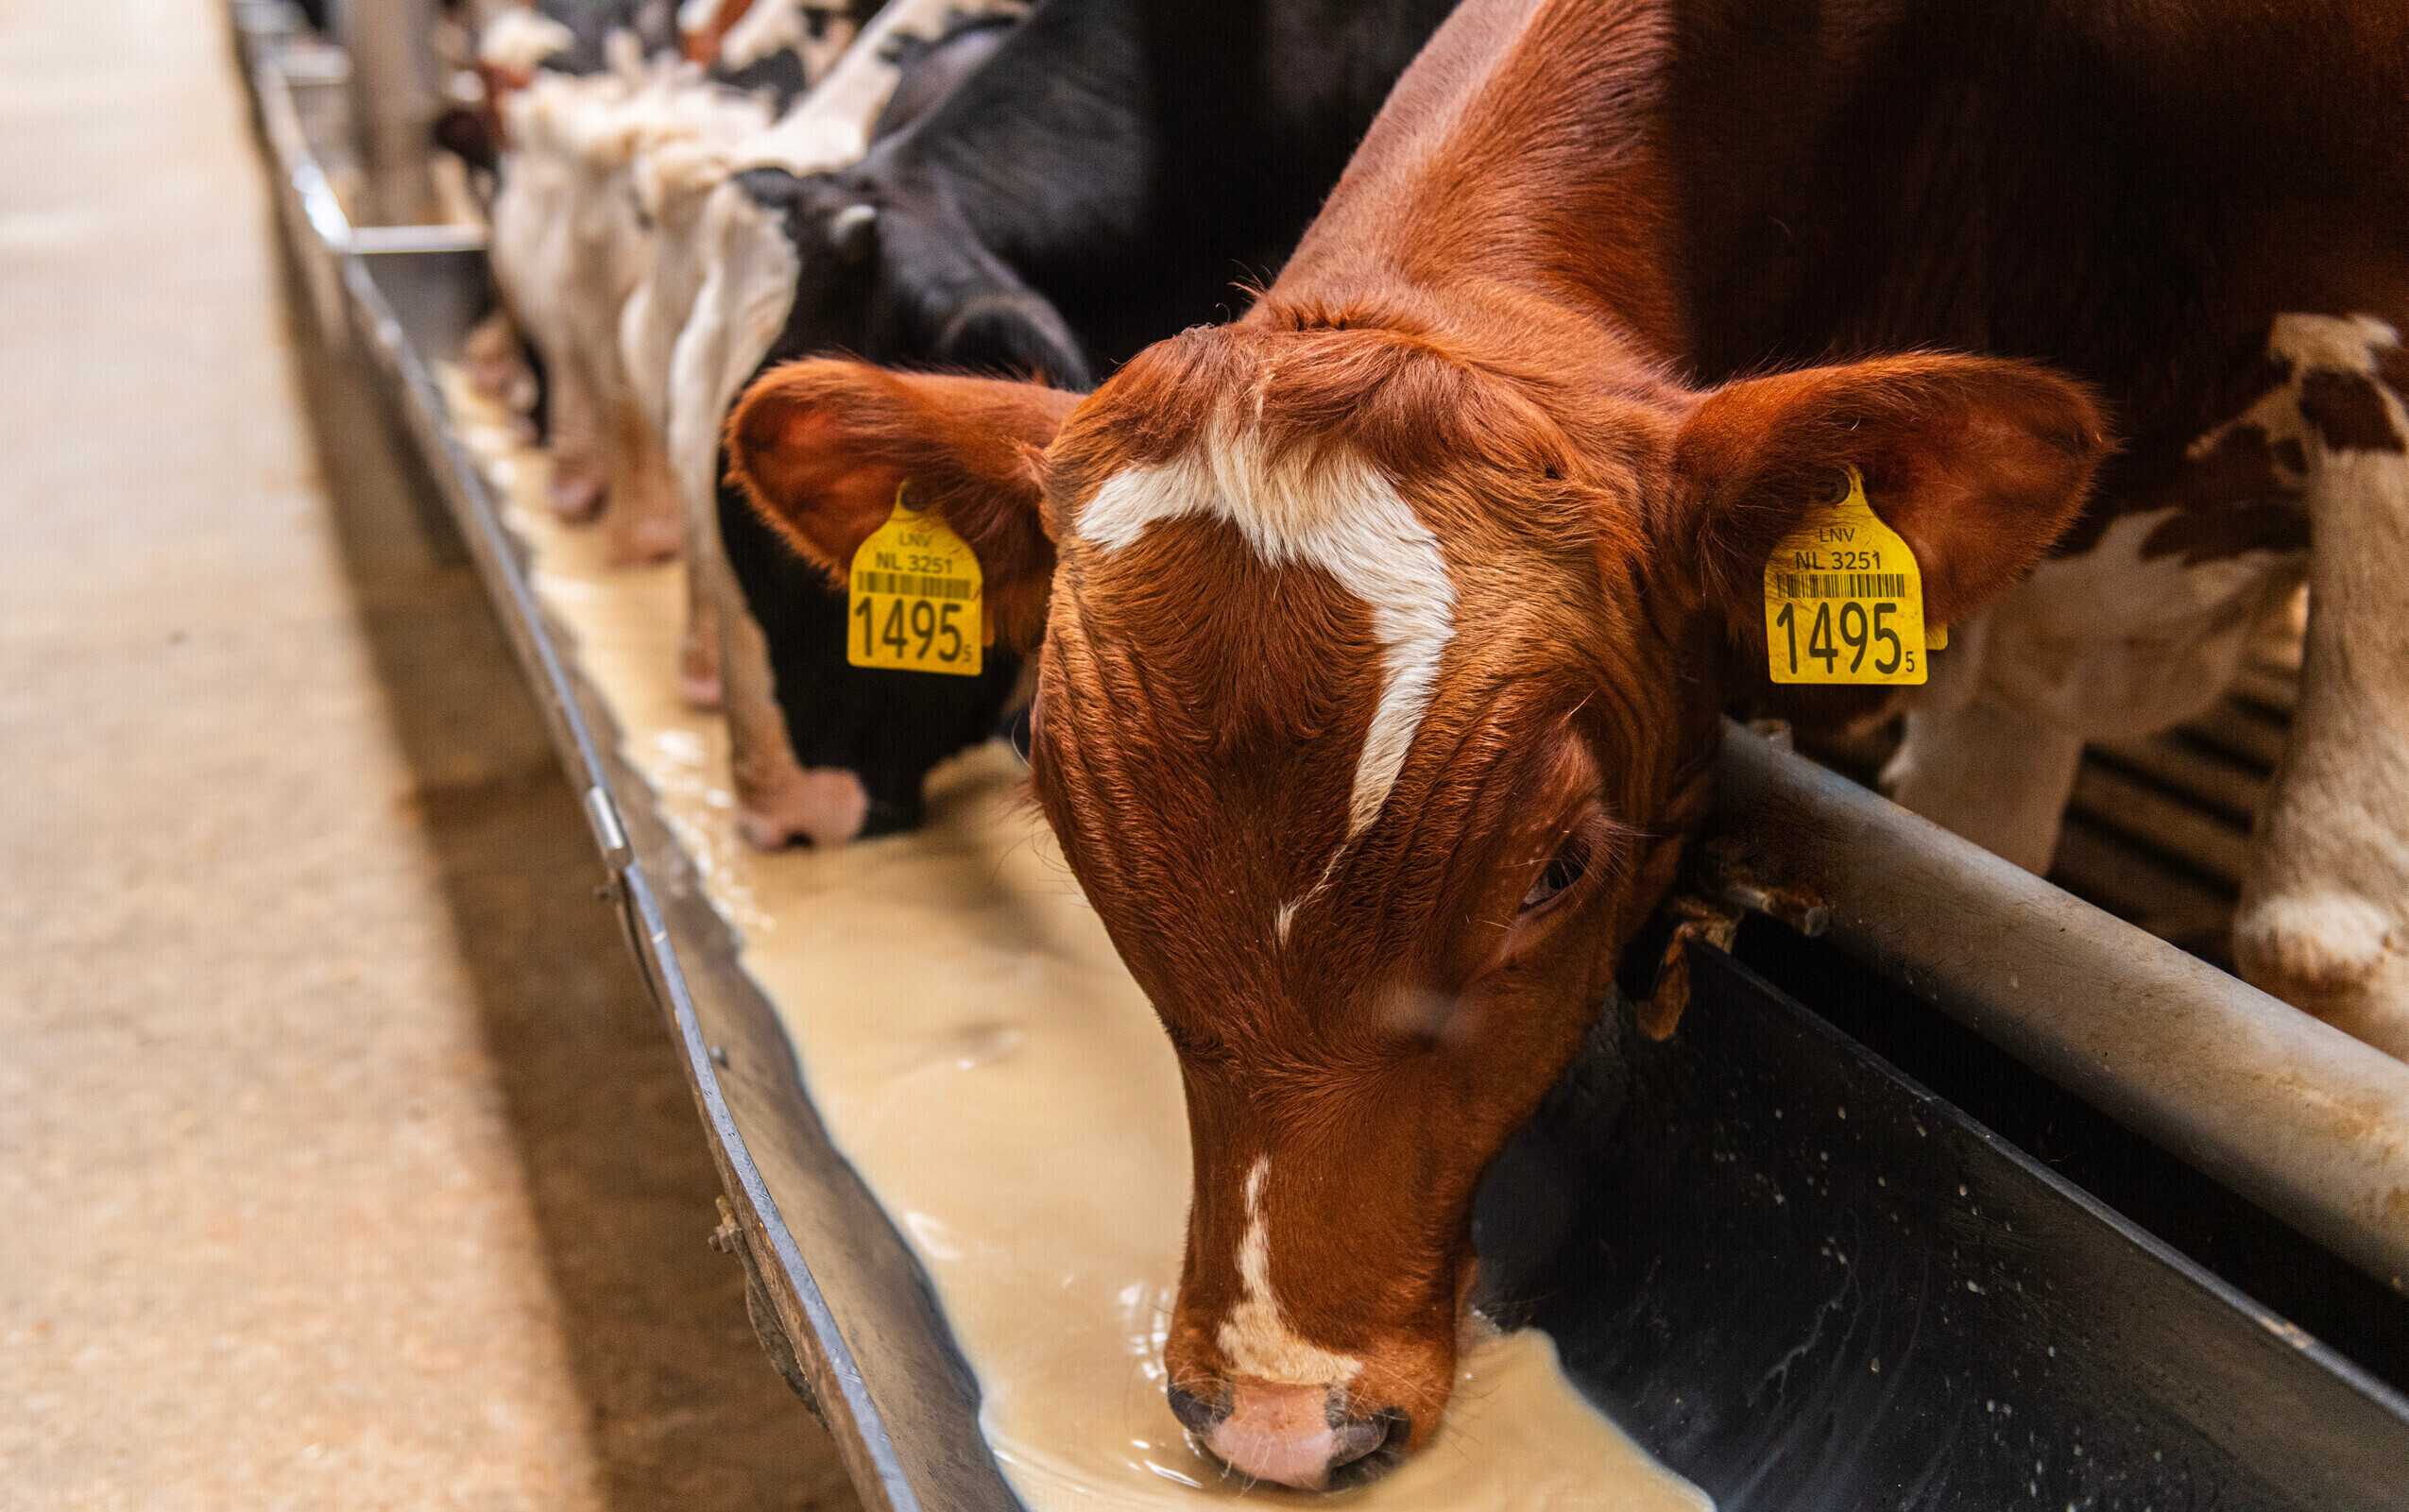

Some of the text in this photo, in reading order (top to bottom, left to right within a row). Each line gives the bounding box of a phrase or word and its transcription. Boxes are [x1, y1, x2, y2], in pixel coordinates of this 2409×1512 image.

[898, 532, 933, 548] LNV
[1819, 528, 1855, 543] LNV
[876, 552, 953, 574] NL 3251
[1796, 552, 1881, 570] NL 3251
[855, 596, 963, 663] 1495
[1776, 602, 1915, 674] 1495 5
